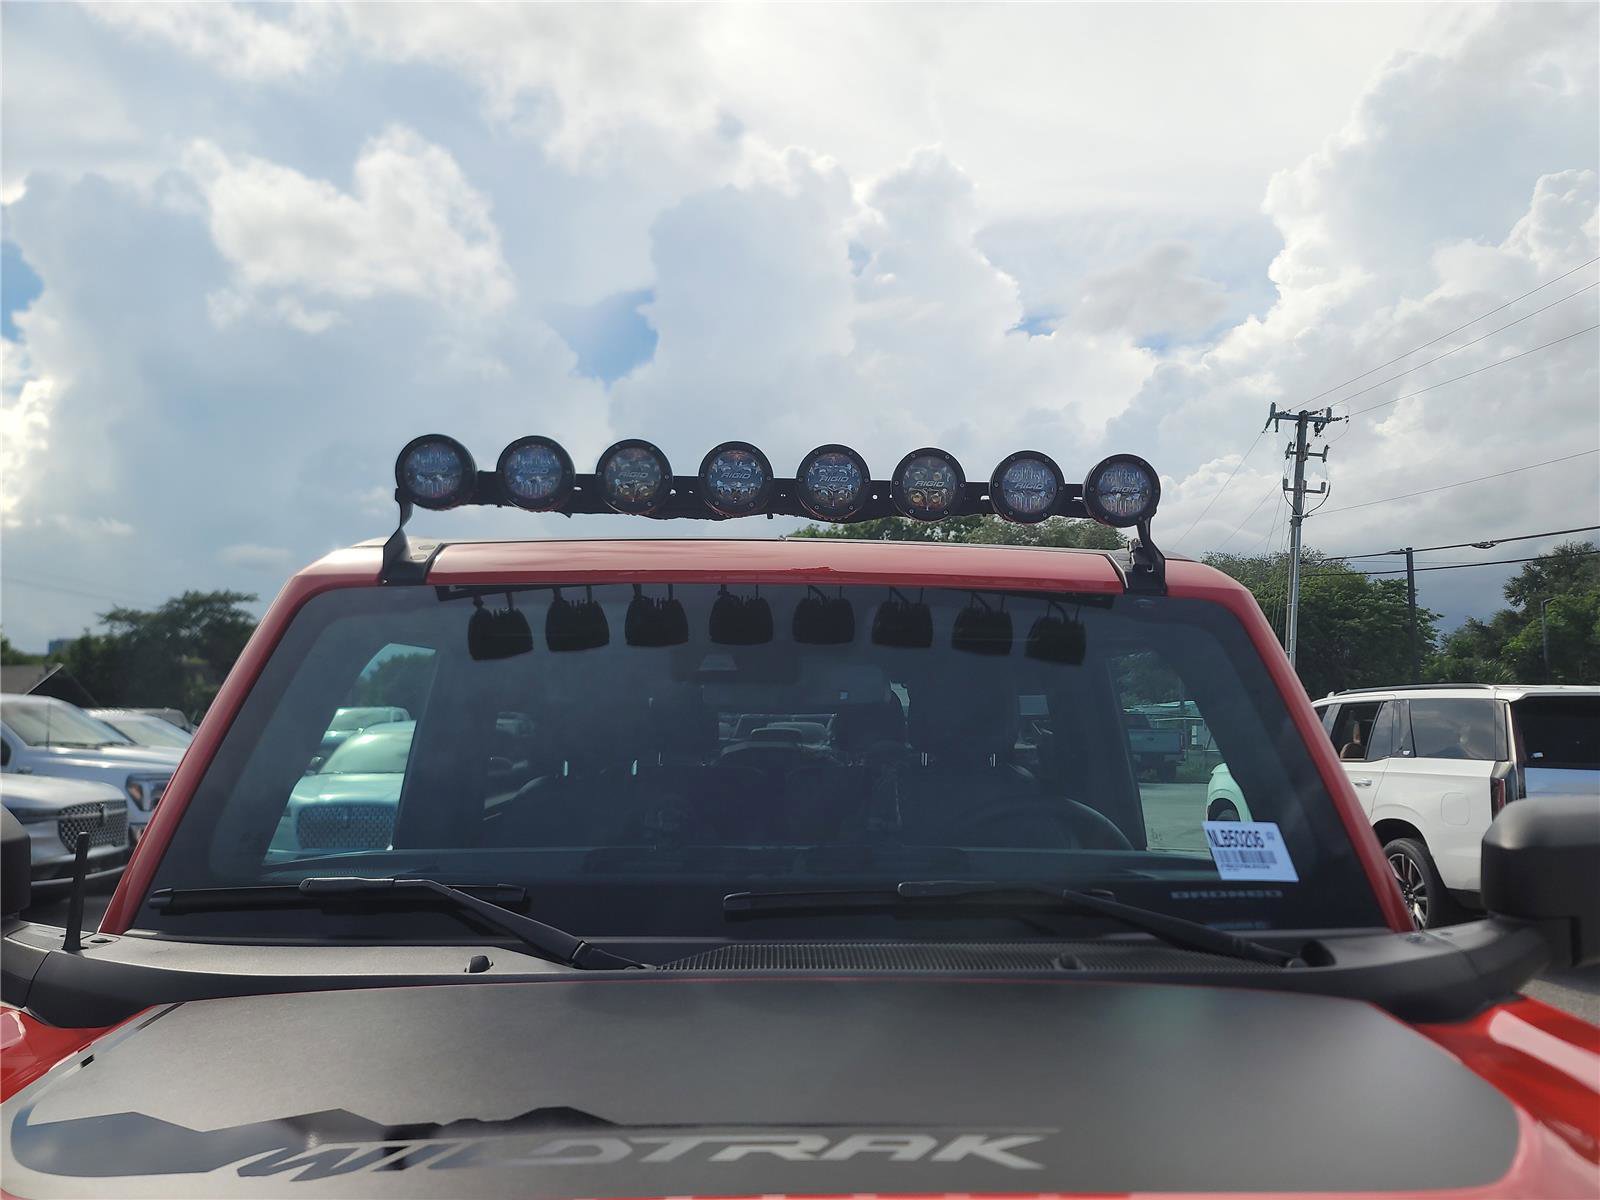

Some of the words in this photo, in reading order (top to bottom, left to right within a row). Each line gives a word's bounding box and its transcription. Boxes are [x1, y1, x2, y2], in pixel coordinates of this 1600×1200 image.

[618, 470, 649, 479] RIGID
[720, 471, 752, 480] RIGID
[819, 473, 849, 483] RIGID
[914, 478, 945, 487] RIGID
[1014, 480, 1045, 490] RIGID
[1110, 485, 1141, 494] RIGID
[237, 1134, 1046, 1182] WILDTRAK
